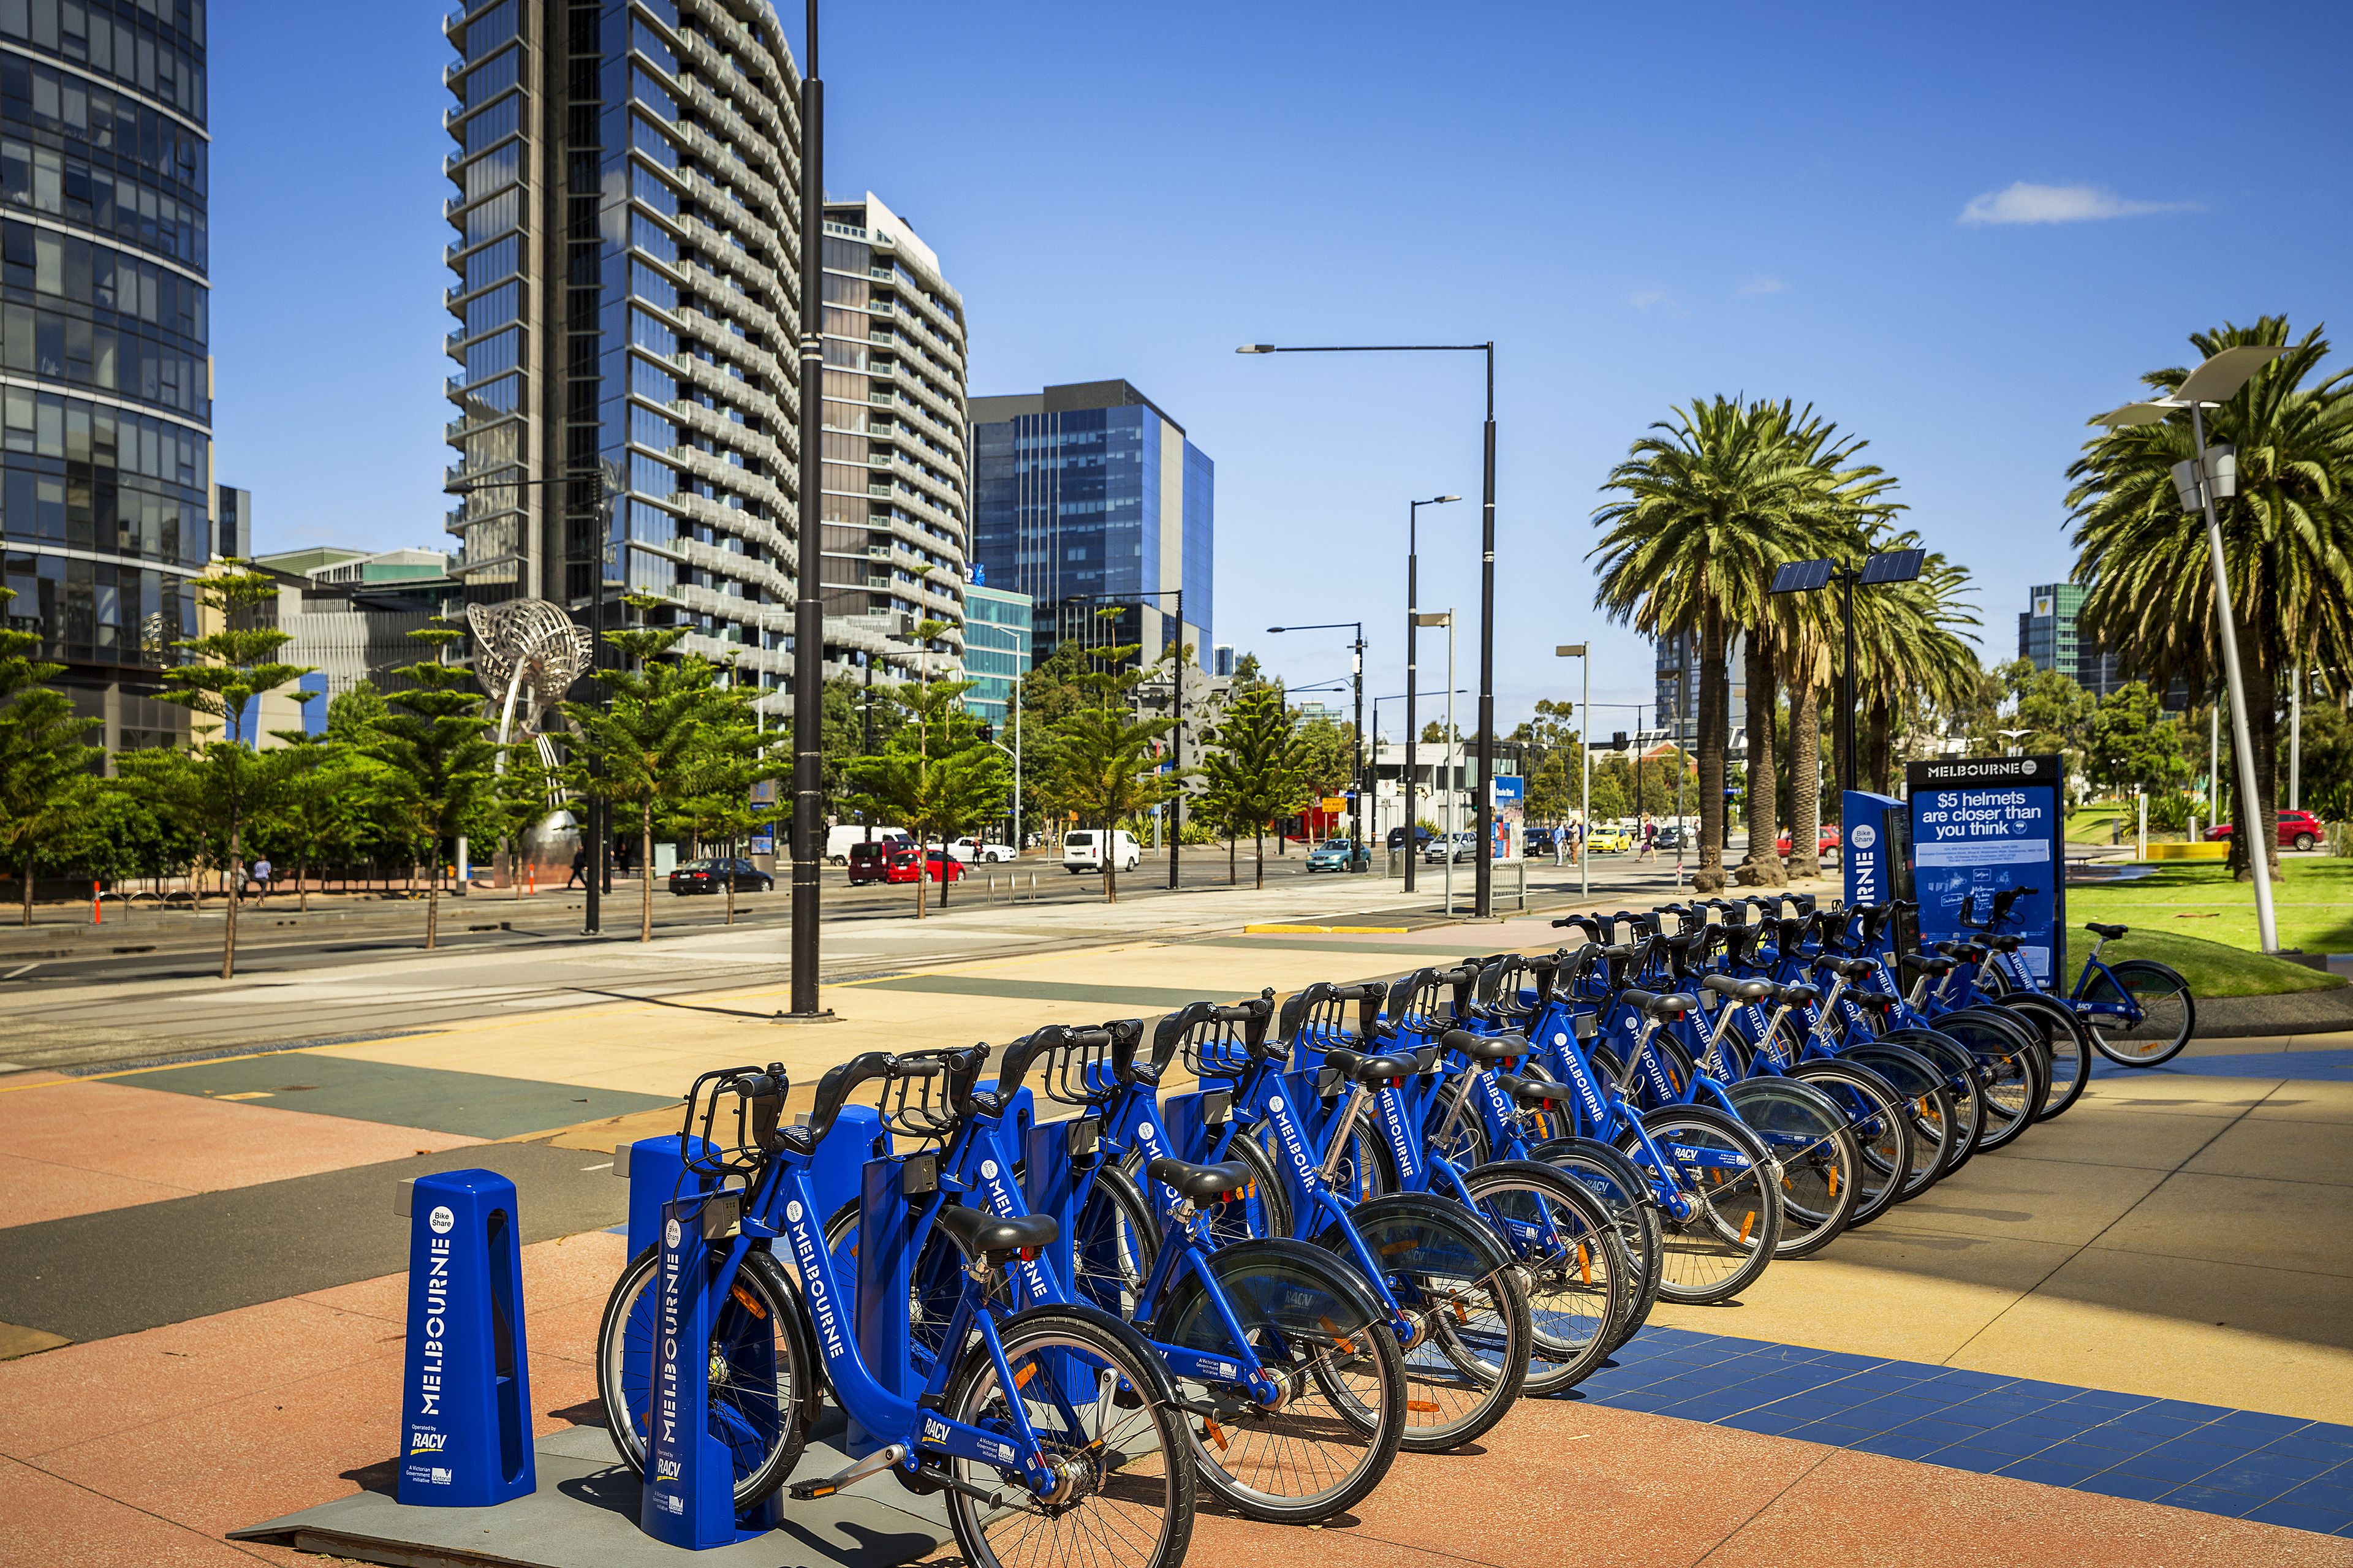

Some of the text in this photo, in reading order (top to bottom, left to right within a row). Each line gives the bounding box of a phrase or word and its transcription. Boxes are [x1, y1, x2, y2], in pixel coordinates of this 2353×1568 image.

[1927, 762, 2020, 779] MELBOURNE
[1937, 790, 2026, 809] $5 helmets
[1922, 805, 2042, 824] are closer than
[1935, 820, 2009, 841] you think
[1631, 1028, 1672, 1101] MBOURNE
[1559, 1044, 1605, 1123] MELBOURNE
[1379, 1086, 1414, 1178] MELBOURNE
[1675, 1147, 1699, 1159] RACV
[432, 1219, 452, 1227] Share
[669, 1225, 678, 1233] Bike
[667, 1232, 680, 1241] Share
[792, 1221, 845, 1360] MELBOURNE
[420, 1238, 451, 1416] MELBOURNE
[662, 1252, 680, 1444] MELBOURNE
[924, 1417, 951, 1441] RACV
[412, 1433, 448, 1449] RACV
[657, 1458, 681, 1478] RACV
